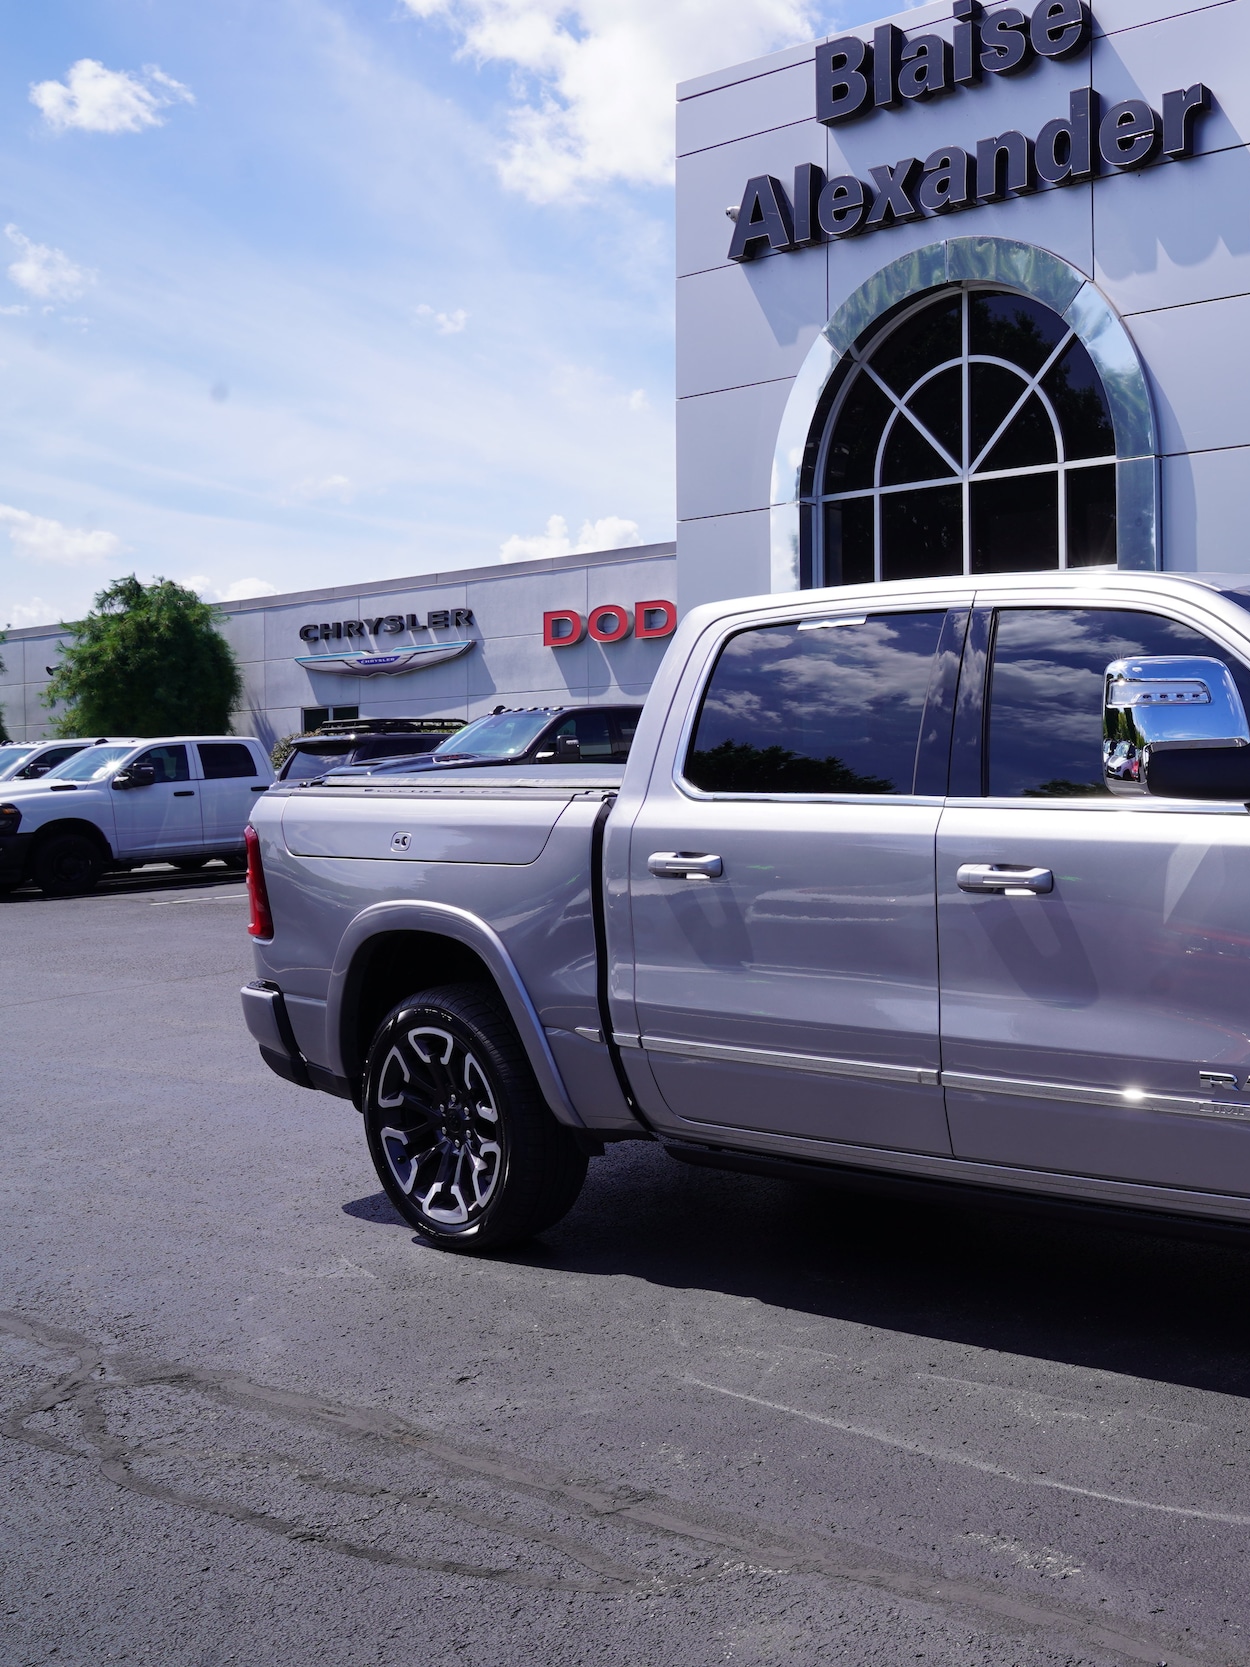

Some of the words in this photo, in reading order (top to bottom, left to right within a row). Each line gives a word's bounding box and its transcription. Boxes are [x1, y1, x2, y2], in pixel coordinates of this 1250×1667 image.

[815, 0, 1092, 126] Blaise
[727, 82, 1212, 261] Alexander
[300, 608, 474, 643] CHRYSLER
[543, 599, 678, 648] DOD
